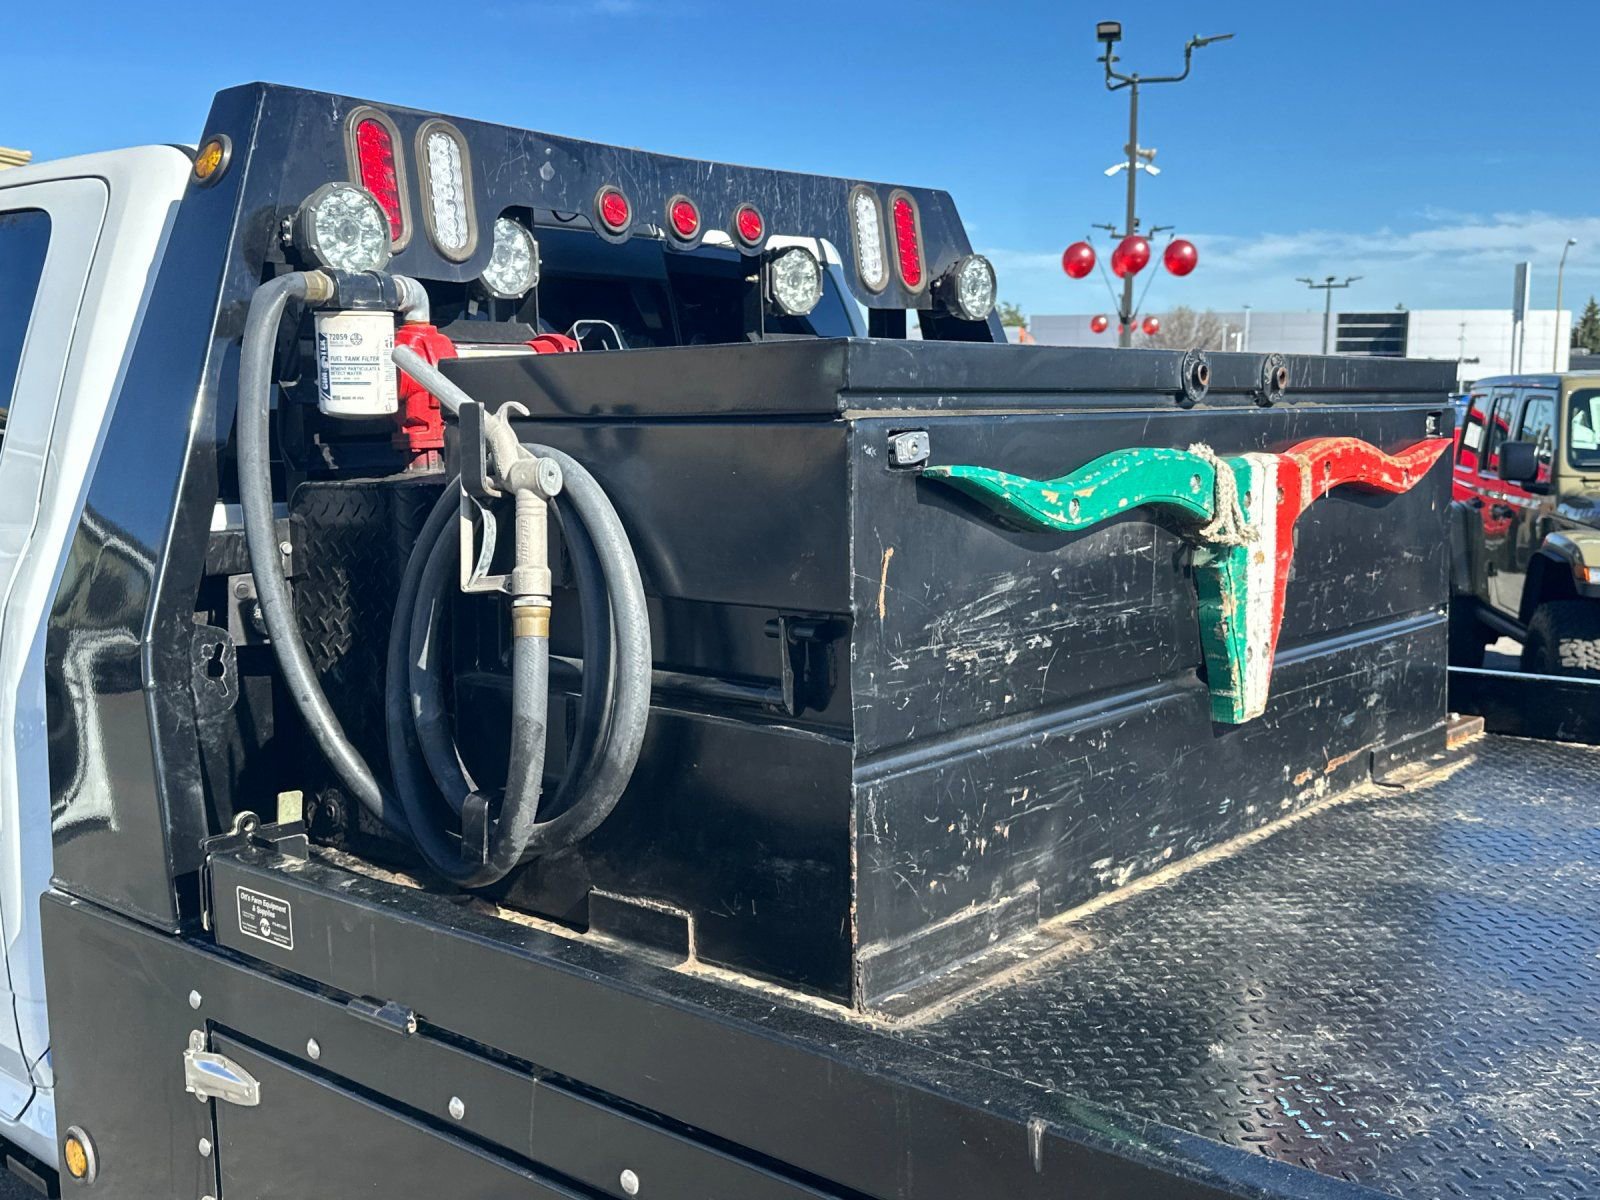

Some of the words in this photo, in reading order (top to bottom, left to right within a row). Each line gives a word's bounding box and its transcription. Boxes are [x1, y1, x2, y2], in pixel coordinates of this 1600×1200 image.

[329, 333, 348, 341] 72059
[251, 895, 263, 905] Farm
[262, 899, 287, 913] Equipment
[256, 906, 275, 918] Supplies
